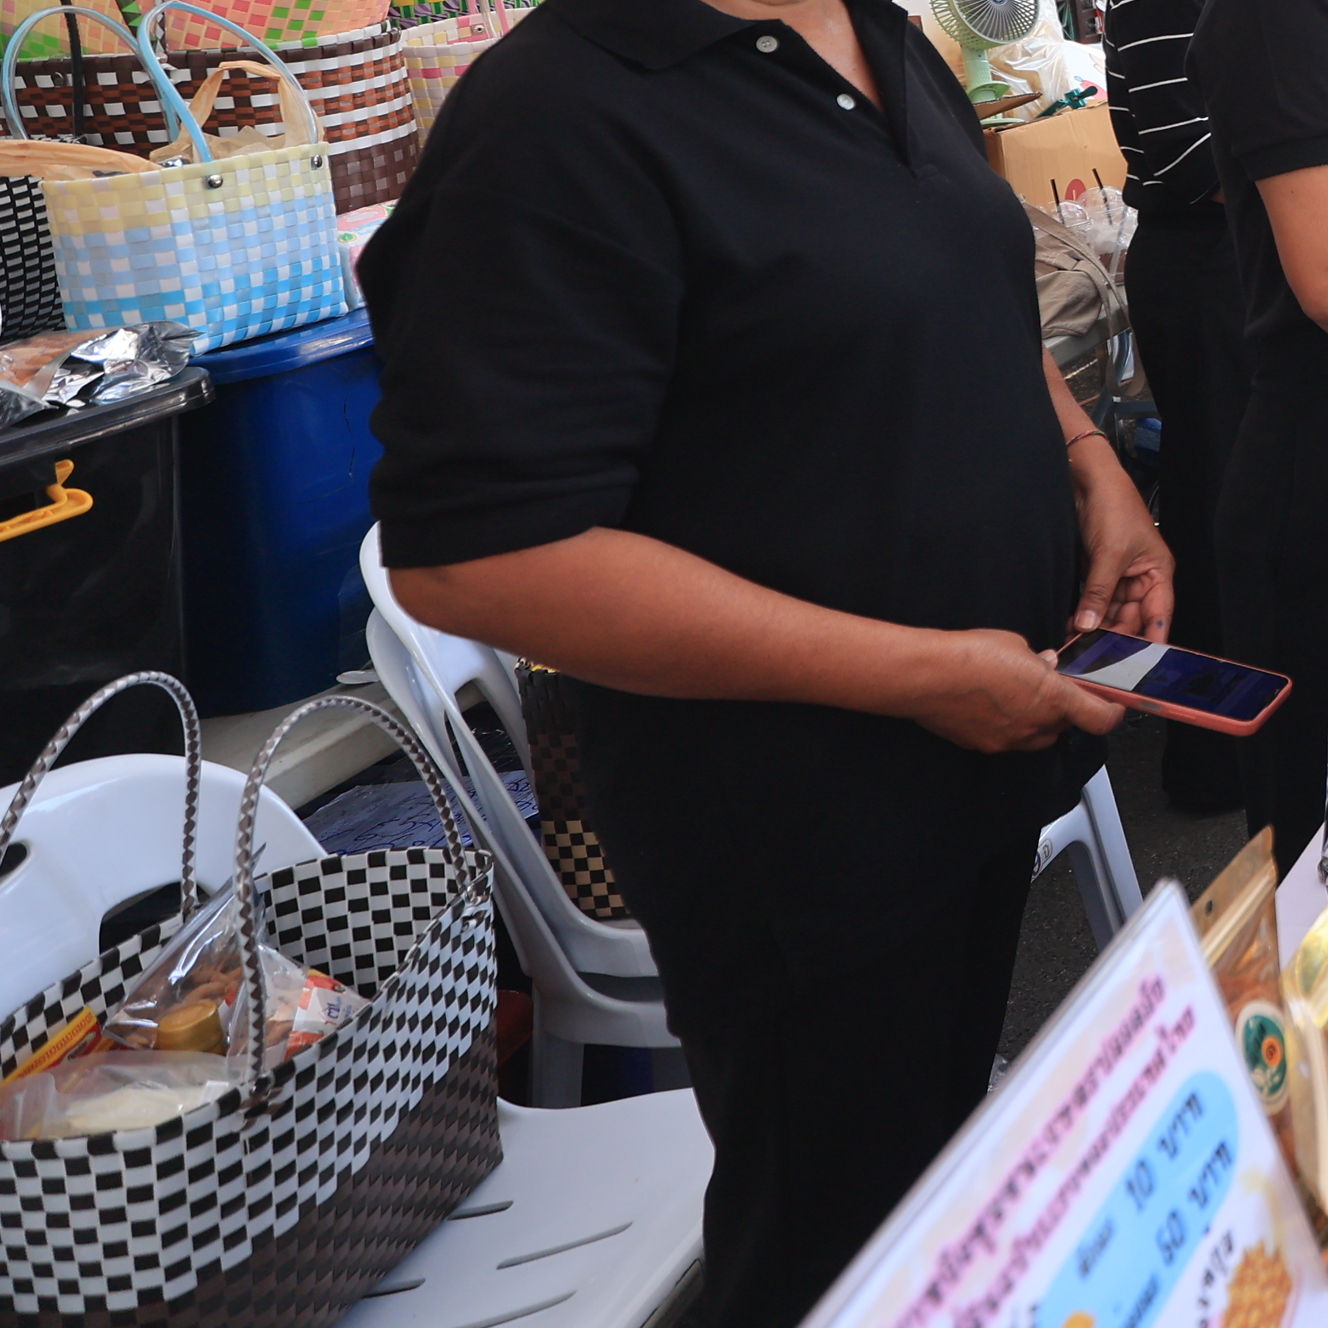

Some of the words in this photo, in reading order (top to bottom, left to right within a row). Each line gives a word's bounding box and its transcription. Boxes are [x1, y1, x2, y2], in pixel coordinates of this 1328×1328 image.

[1125, 1158, 1155, 1213] 10
[1158, 1091, 1204, 1161] บาท
[1188, 1139, 1233, 1209] บาท
